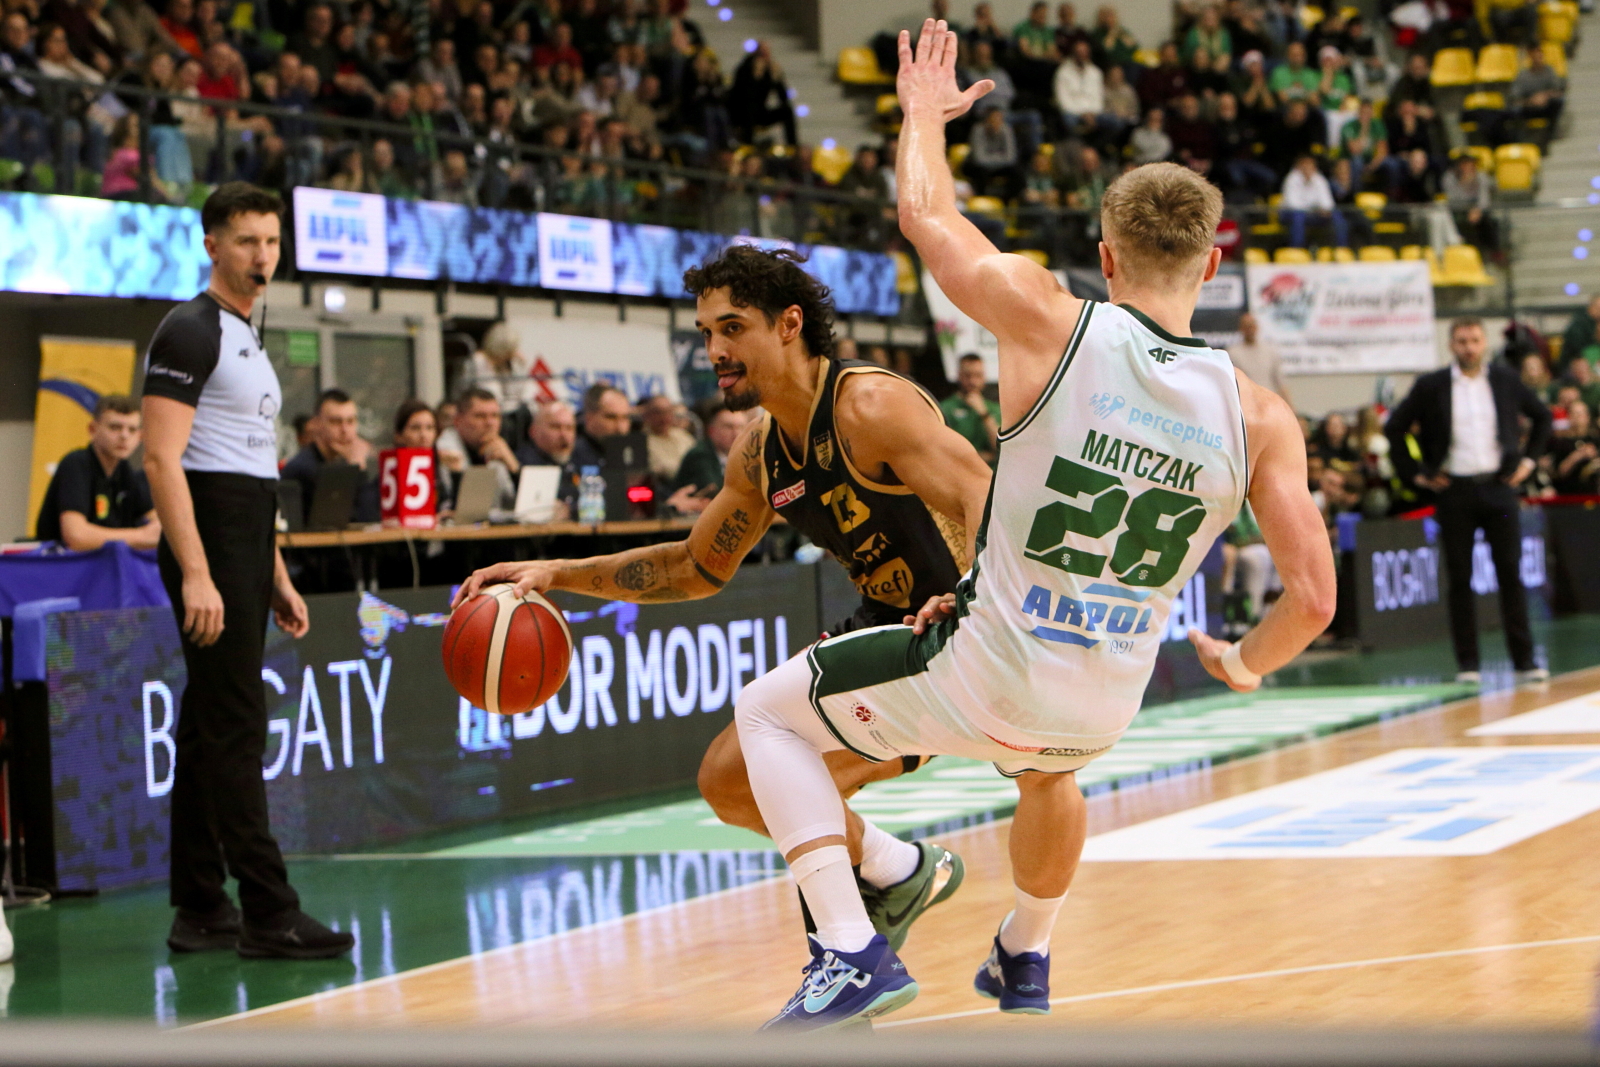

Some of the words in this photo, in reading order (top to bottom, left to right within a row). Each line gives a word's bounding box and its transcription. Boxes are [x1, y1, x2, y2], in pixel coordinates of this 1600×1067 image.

[1148, 347, 1178, 364] 4F
[1127, 406, 1224, 450] perceptus
[403, 455, 432, 511] 5
[1080, 429, 1204, 492] MATCZAK
[1024, 455, 1208, 587] 28
[1021, 584, 1153, 635] ARPOL
[142, 654, 393, 798] BGATY
